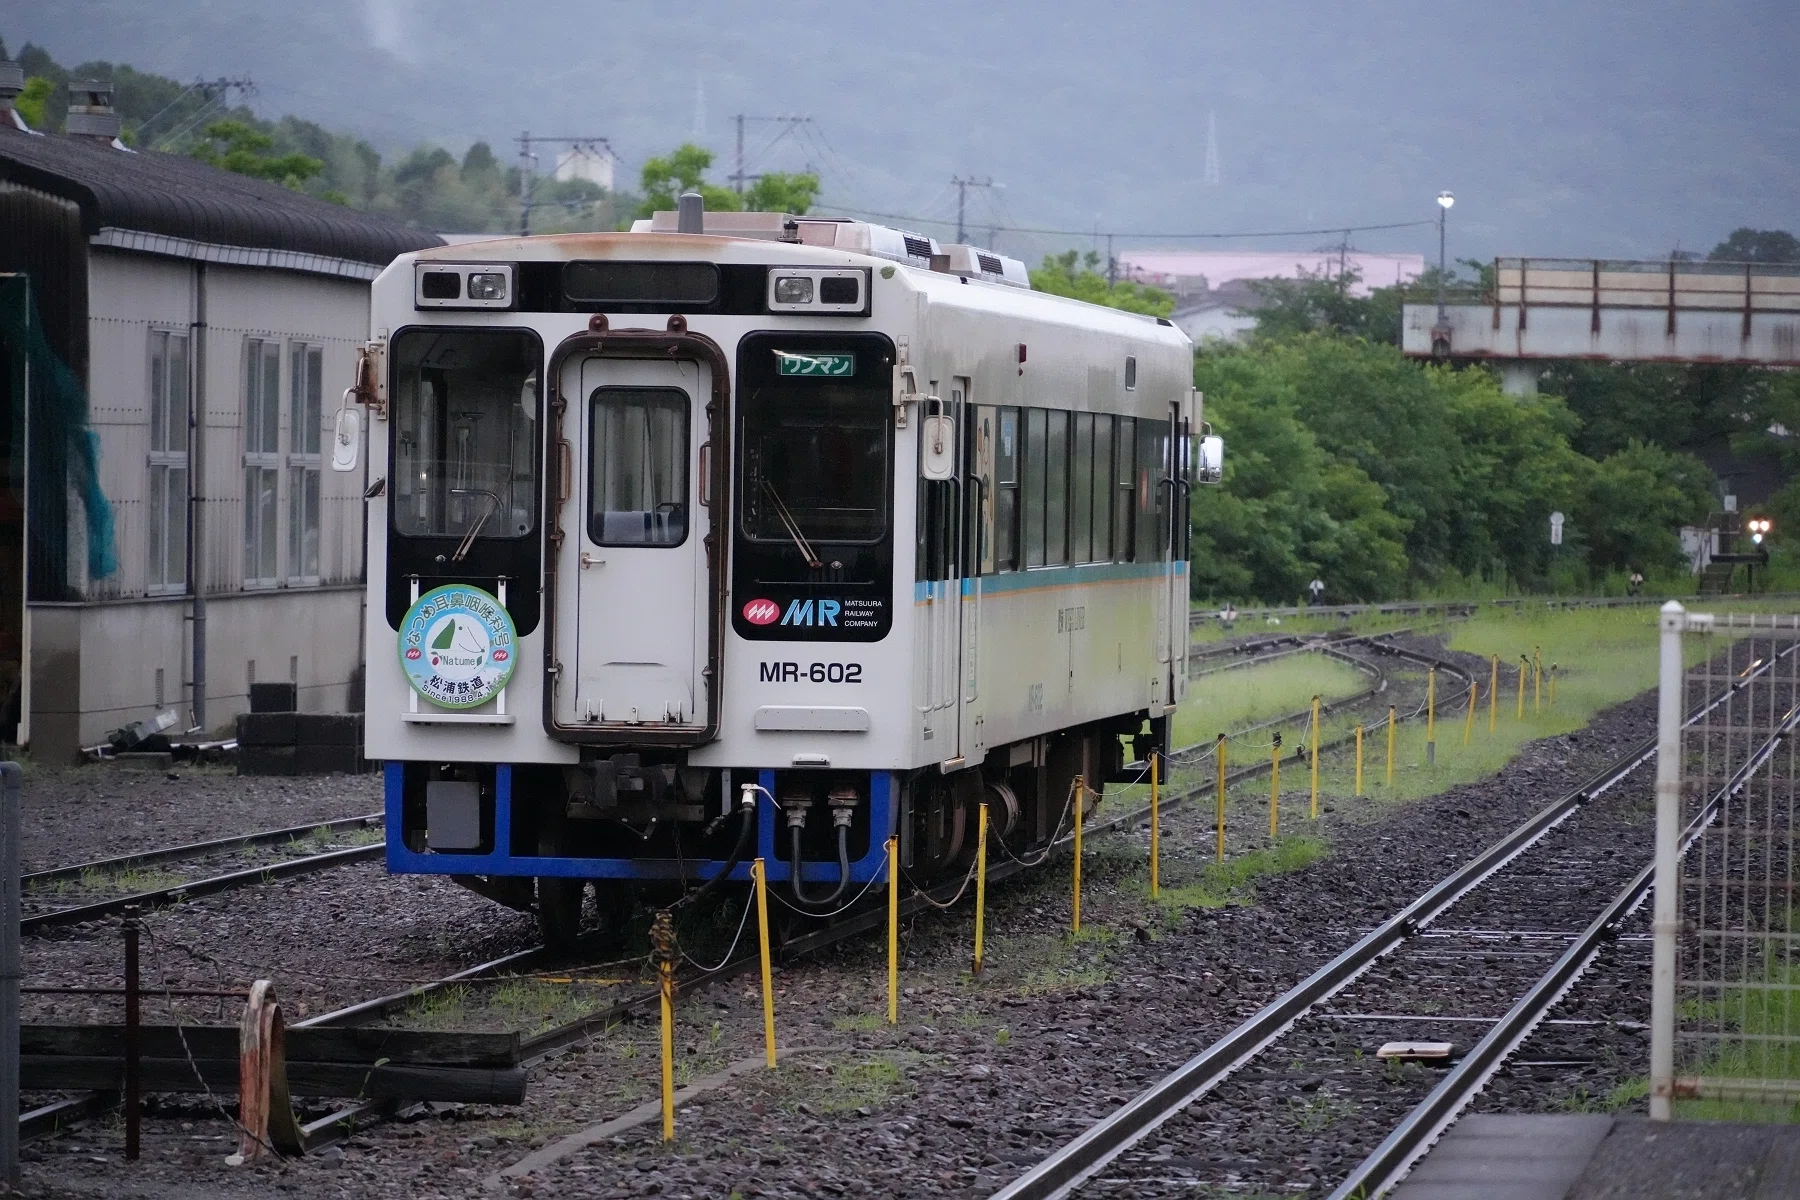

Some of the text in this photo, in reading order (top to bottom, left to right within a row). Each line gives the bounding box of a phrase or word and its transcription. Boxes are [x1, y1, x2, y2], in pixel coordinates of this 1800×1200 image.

[784, 355, 849, 374] ワンマン
[406, 592, 510, 647] なつめ耳鼻咽喉科号
[780, 599, 840, 626] MR
[442, 657, 475, 666] Natume
[760, 661, 862, 683] MR-602
[429, 674, 485, 694] 松浦鉄道
